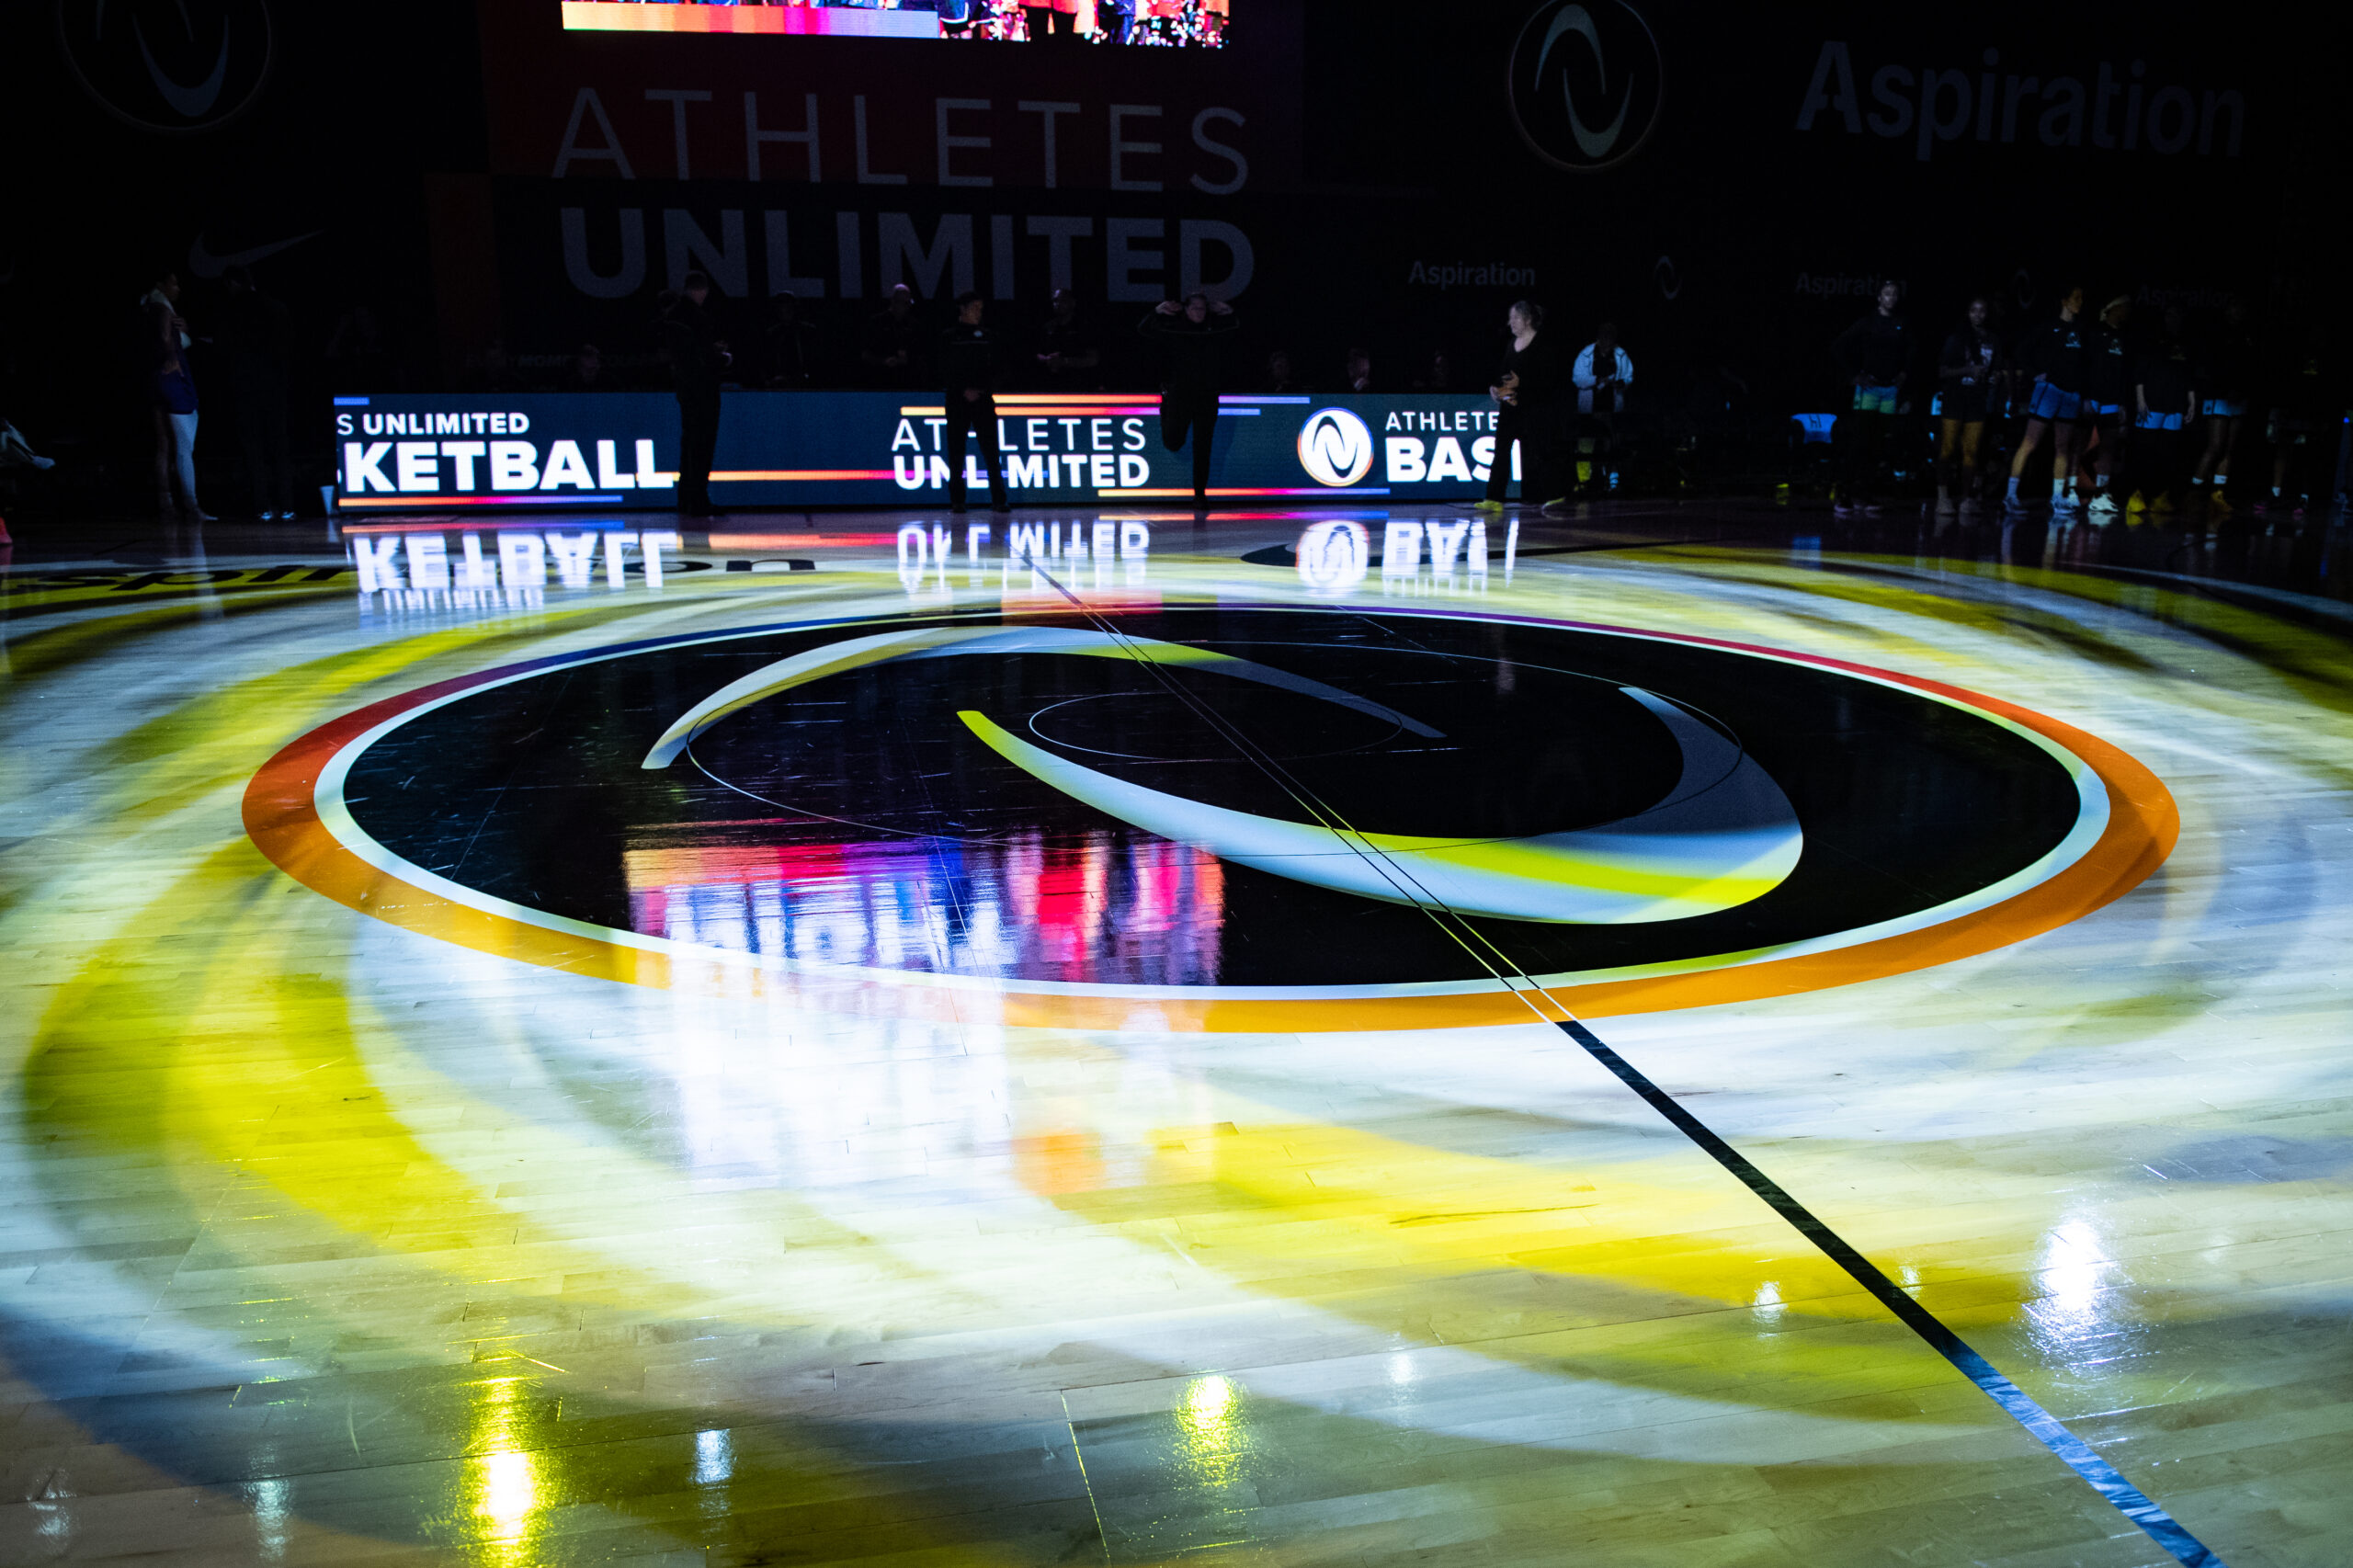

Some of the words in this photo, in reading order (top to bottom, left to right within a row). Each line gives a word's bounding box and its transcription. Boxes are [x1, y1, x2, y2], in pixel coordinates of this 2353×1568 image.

[1793, 40, 2247, 162] Aspiration
[551, 86, 1249, 195] ATHLETES
[560, 207, 1255, 302] UNLIMITED
[1407, 259, 1537, 291] Aspiration
[1795, 271, 1907, 300] Aspiratin
[363, 412, 529, 435] UNLIMITED
[891, 417, 1147, 452] ATLETES
[1385, 411, 1500, 433] ATHLETE
[337, 439, 674, 493] KETBALL
[892, 454, 1151, 491] UNLMITED
